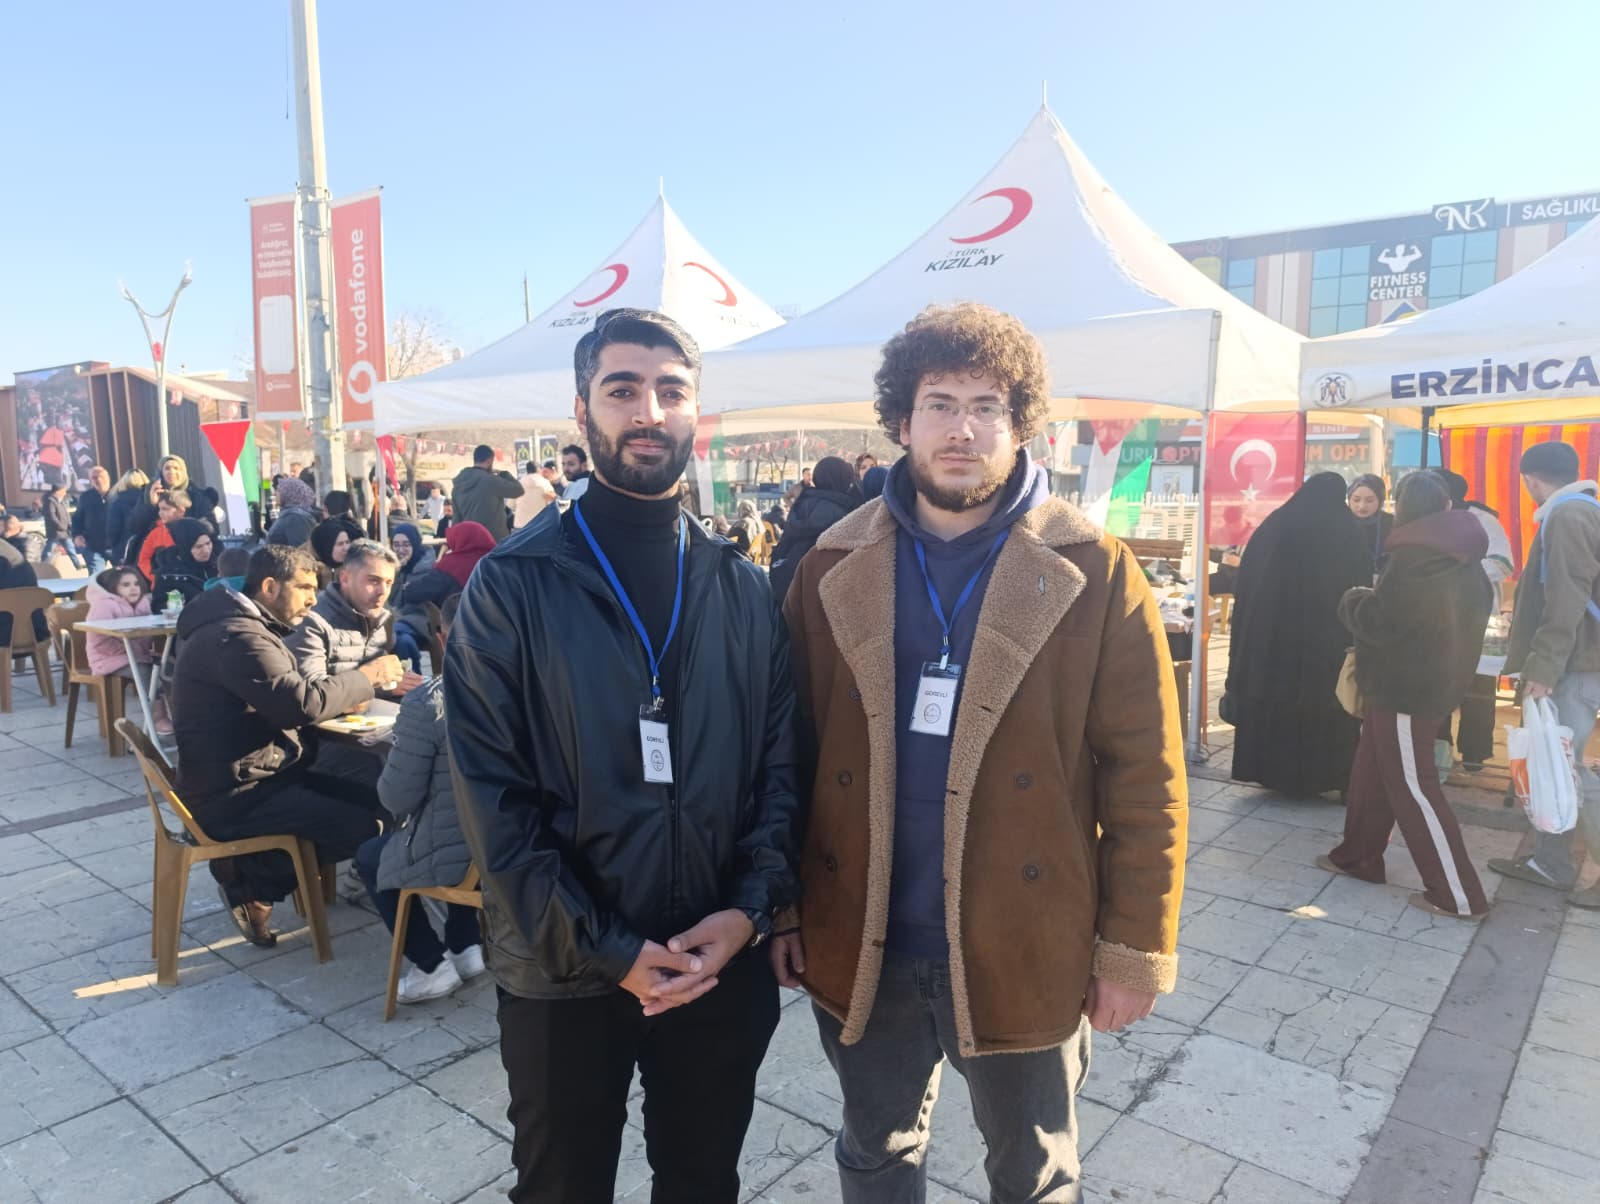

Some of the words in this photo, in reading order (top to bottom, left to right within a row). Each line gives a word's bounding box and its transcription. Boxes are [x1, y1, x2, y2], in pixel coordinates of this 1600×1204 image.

[924, 254, 1004, 273] KIZILAY
[1370, 272, 1426, 288] FITNESS
[348, 229, 368, 354] vodafone
[1370, 285, 1424, 301] CENTER
[1391, 355, 1600, 399] ERZİNCA
